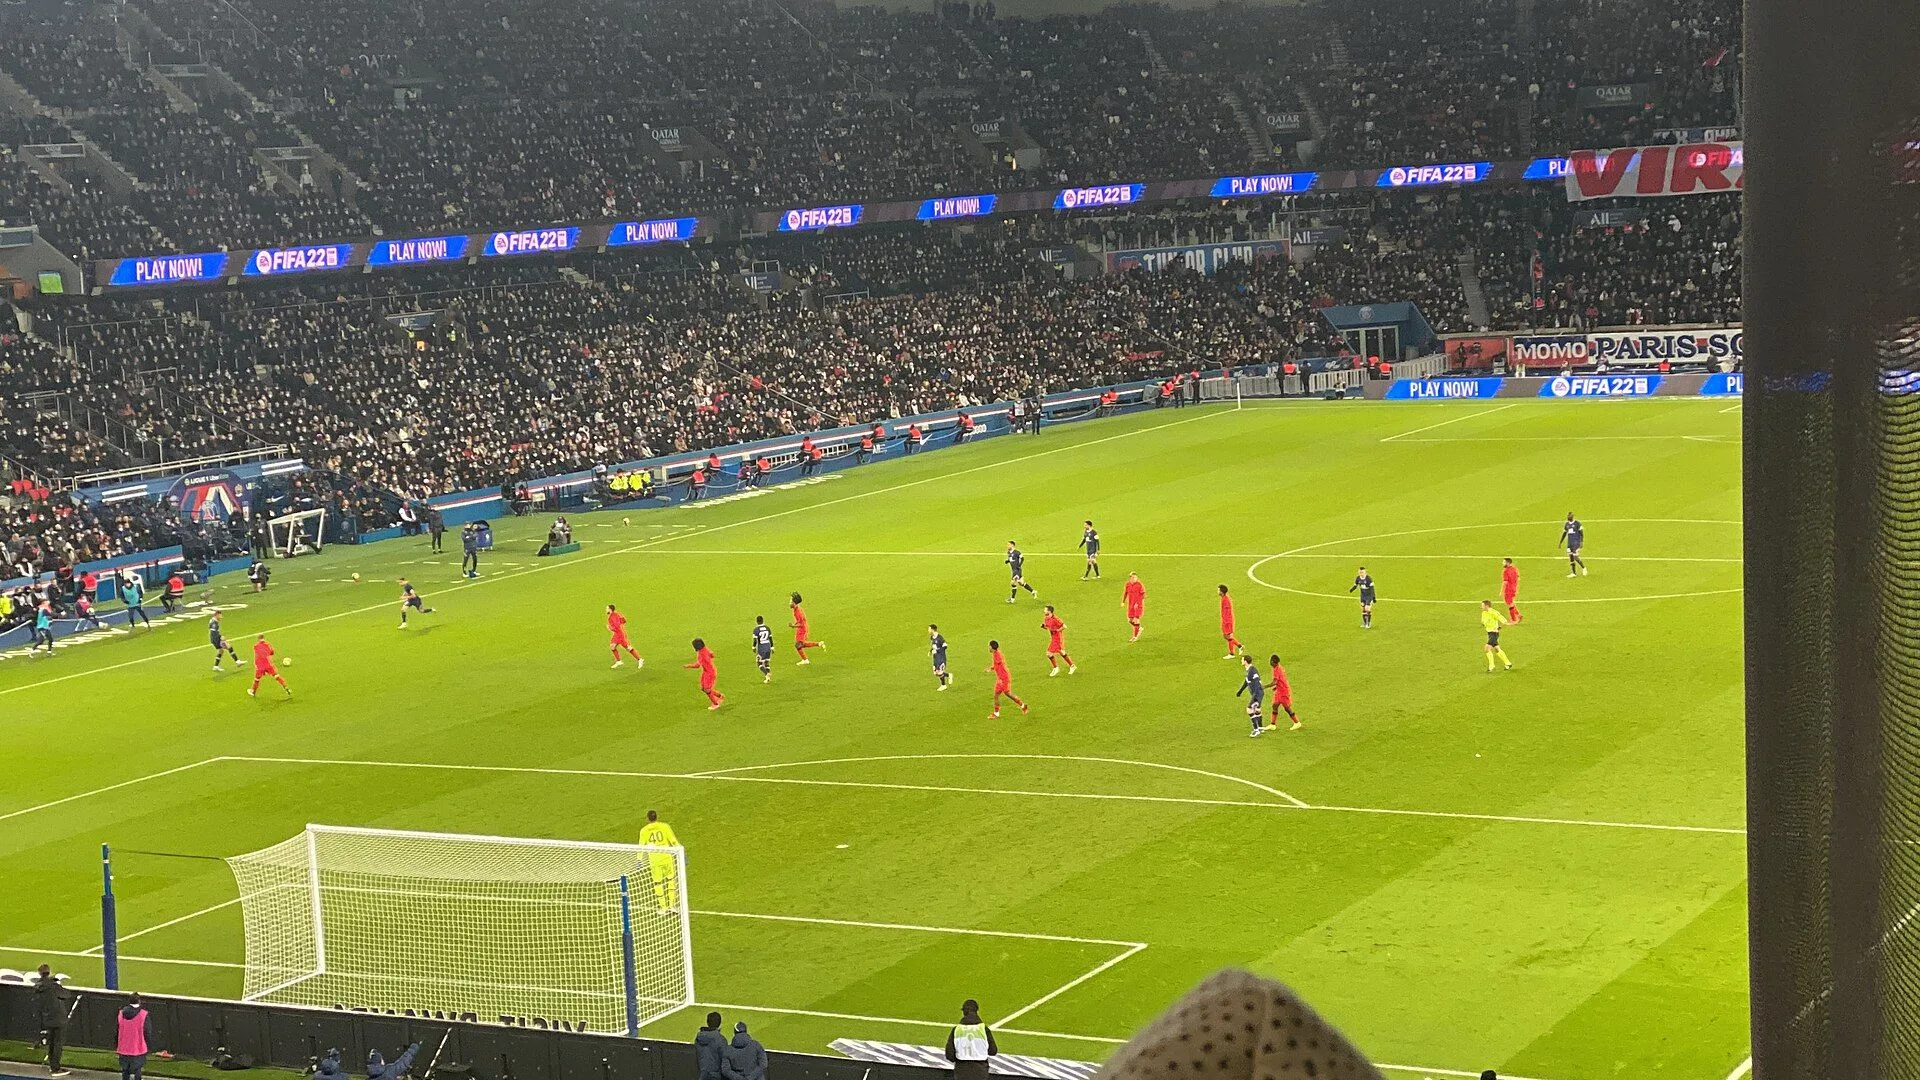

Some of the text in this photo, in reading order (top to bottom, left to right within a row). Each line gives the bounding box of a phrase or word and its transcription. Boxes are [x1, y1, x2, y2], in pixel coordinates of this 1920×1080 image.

[1596, 85, 1632, 98] QATAR
[972, 122, 1000, 135] QATAR
[1267, 114, 1300, 126] QATAR
[651, 129, 680, 141] QATAR
[1571, 144, 1743, 197] VIR
[1231, 176, 1293, 193] PLAY NOW!
[934, 198, 980, 216] PLAY NOW!
[626, 221, 678, 241] PLAY NOW!
[389, 240, 447, 261] PLAY NOW!
[136, 258, 202, 281] PLAY NOW!
[1515, 341, 1587, 360] MOMO
[1595, 335, 1697, 359] PARIS
[1410, 381, 1479, 397] PLAY NOW!
[649, 831, 663, 844] 40
